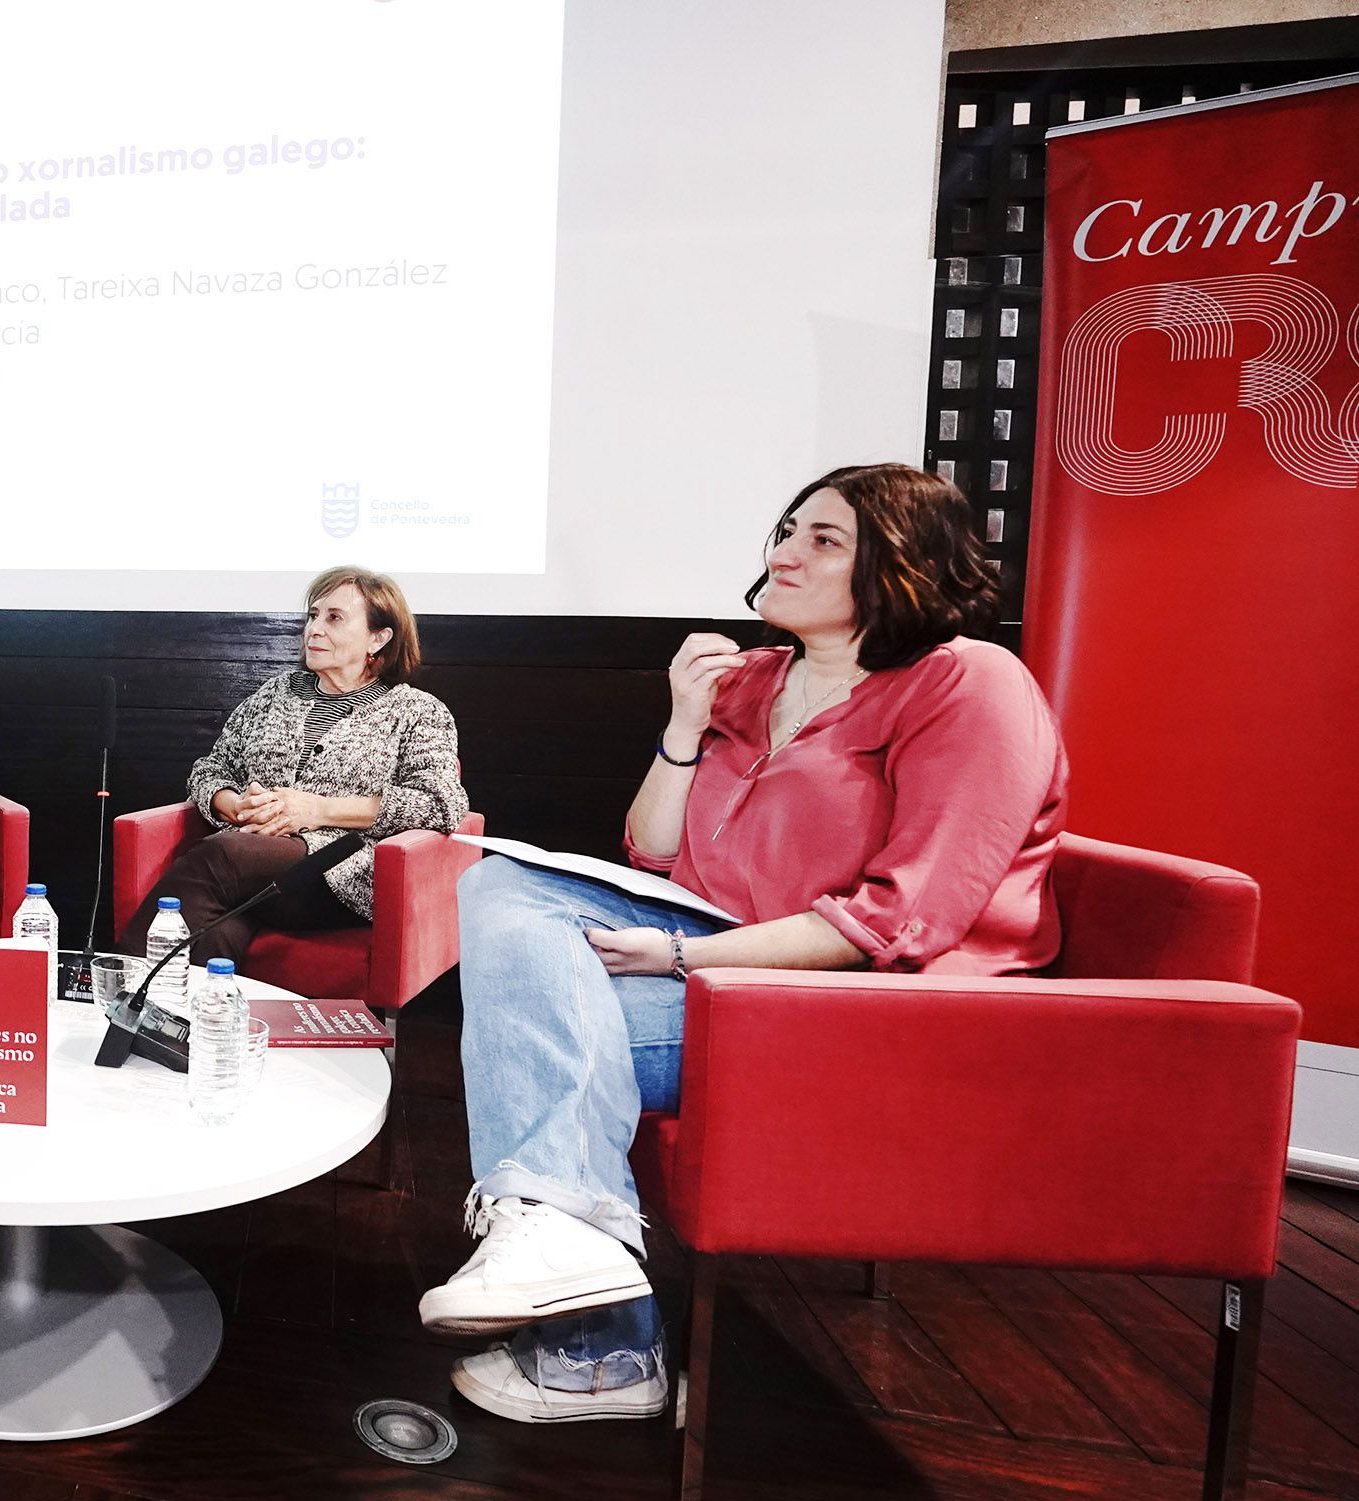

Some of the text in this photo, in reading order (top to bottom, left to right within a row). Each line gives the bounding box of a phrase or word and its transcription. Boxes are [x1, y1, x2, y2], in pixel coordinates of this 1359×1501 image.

[17, 146, 214, 183] xornalismo
[222, 134, 367, 176] galego:
[1072, 181, 1359, 265] Camp
[57, 274, 161, 301] Tareixa
[172, 270, 283, 297] Navaza
[294, 259, 449, 290] González
[14, 1031, 38, 1044] no
